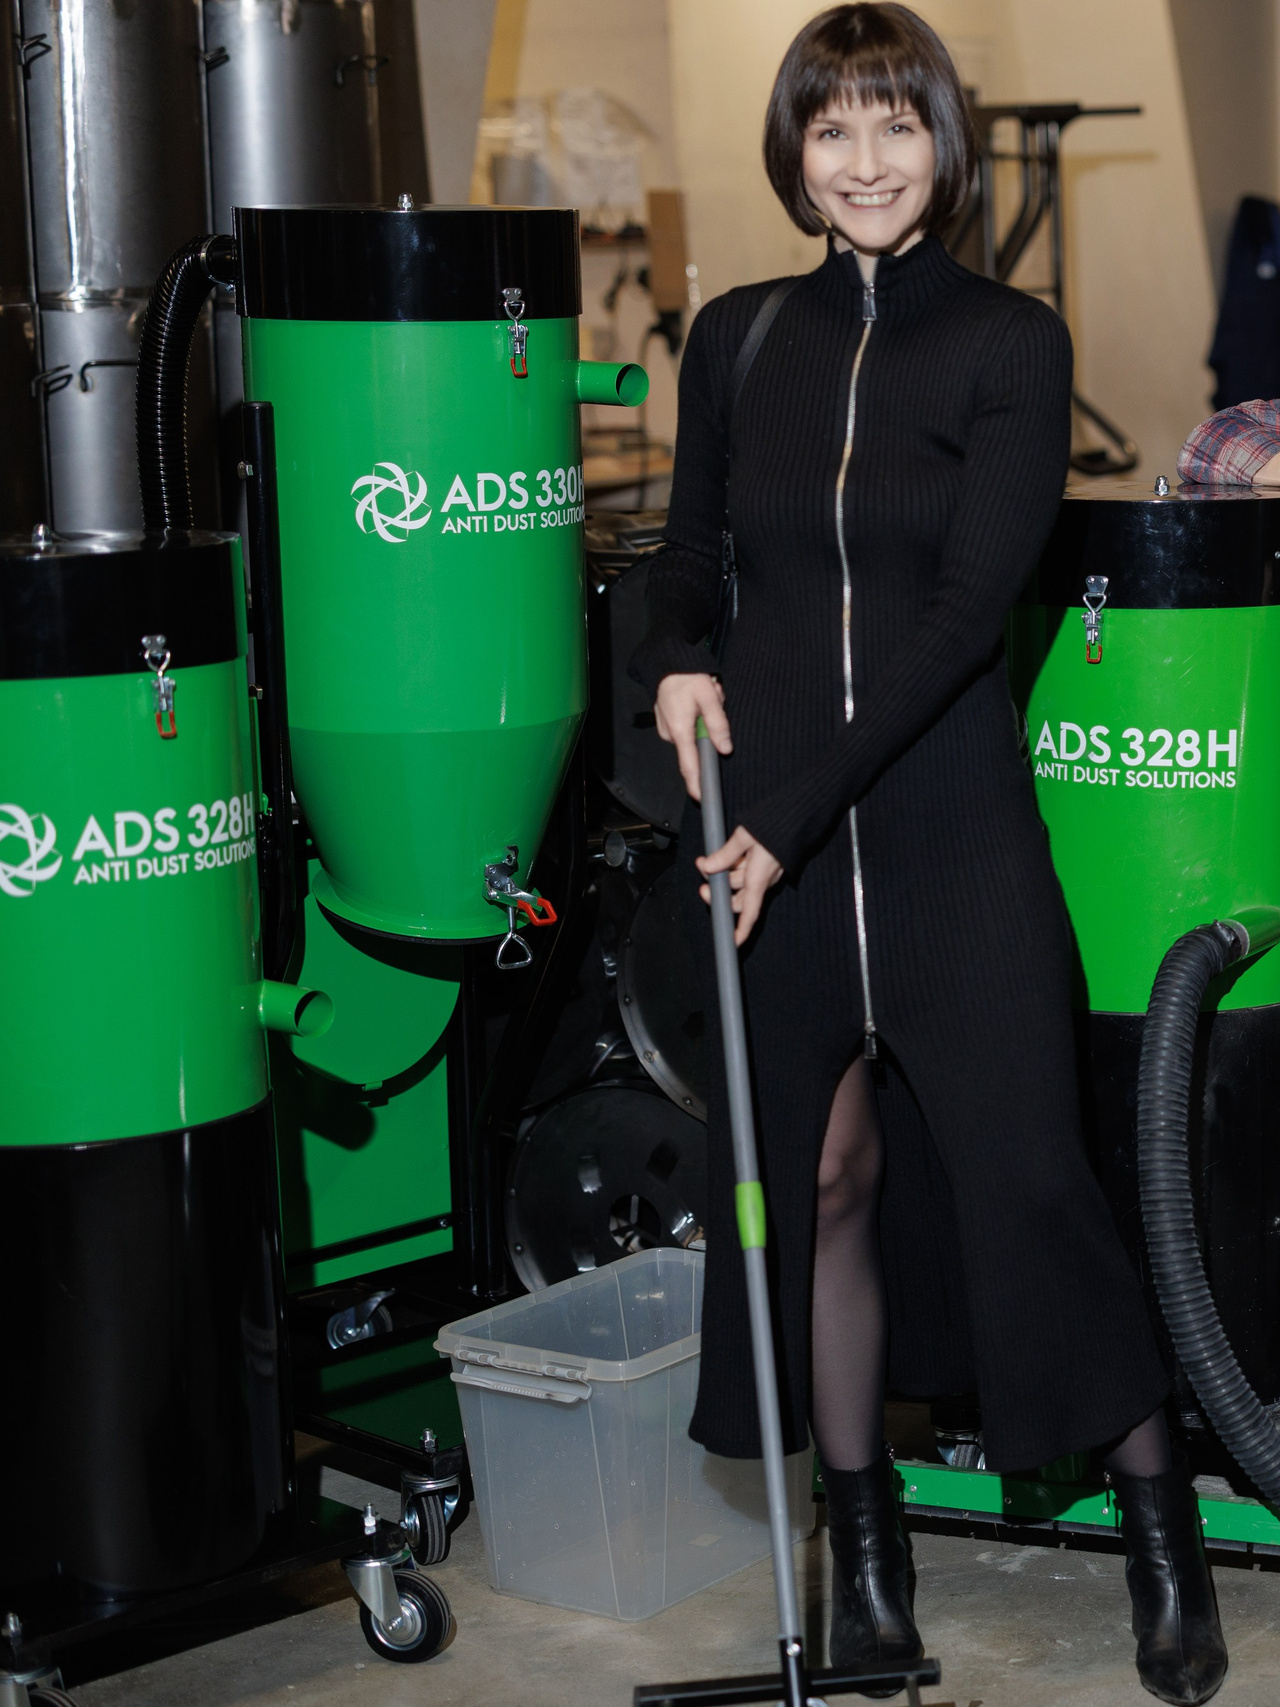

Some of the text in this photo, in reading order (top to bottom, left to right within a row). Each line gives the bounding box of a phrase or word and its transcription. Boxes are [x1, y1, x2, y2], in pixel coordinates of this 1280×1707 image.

[440, 464, 585, 513] ADS 330H
[441, 504, 586, 534] ANTI DUST SOLUTION
[1034, 719, 1237, 768] ADS 328H
[1034, 761, 1236, 788] ANTI DUST SOLUTIONS
[71, 791, 254, 860] ADS 328H
[73, 860, 130, 885] ANTI
[137, 853, 190, 880] DUST
